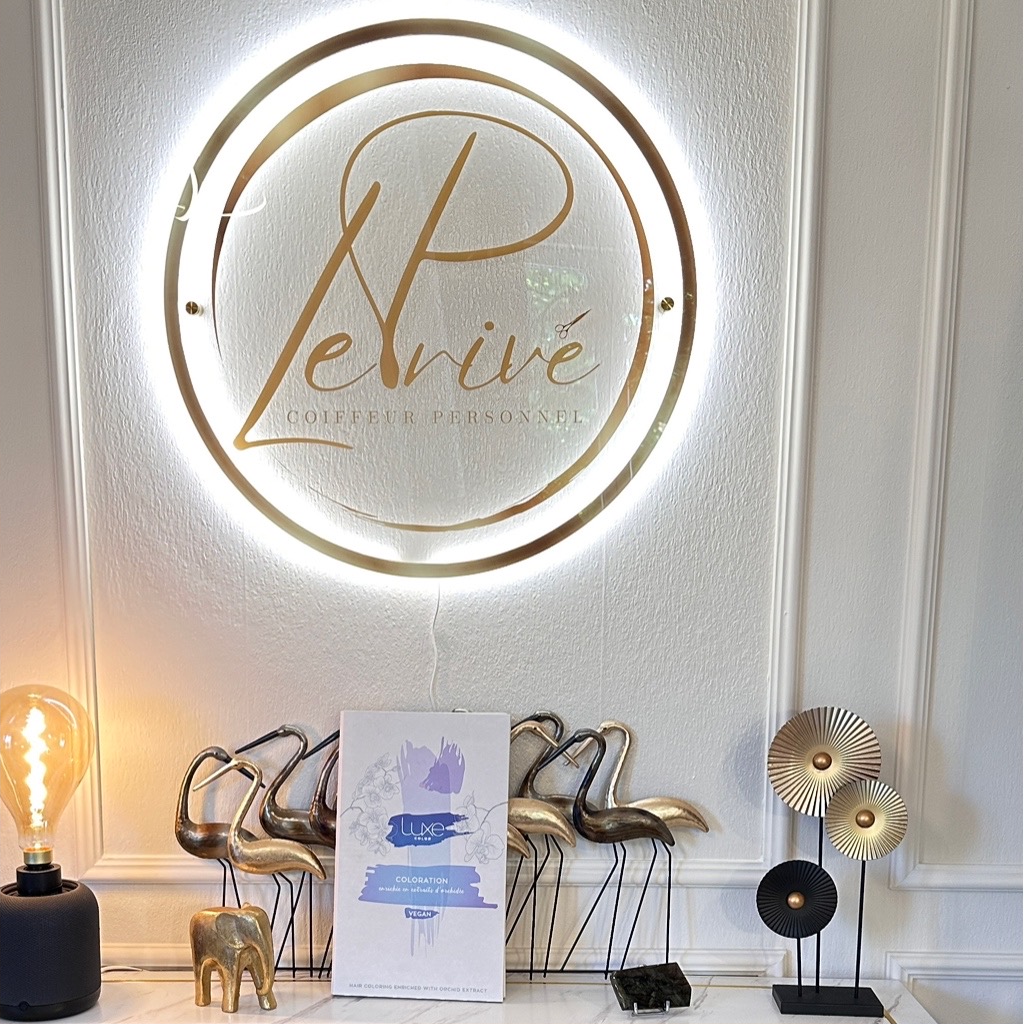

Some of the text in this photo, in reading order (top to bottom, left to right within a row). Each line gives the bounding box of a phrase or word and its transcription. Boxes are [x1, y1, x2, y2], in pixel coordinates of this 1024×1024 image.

[287, 410, 583, 424] COIFFEUR PERSONNEL
[395, 876, 449, 884] COLORATION
